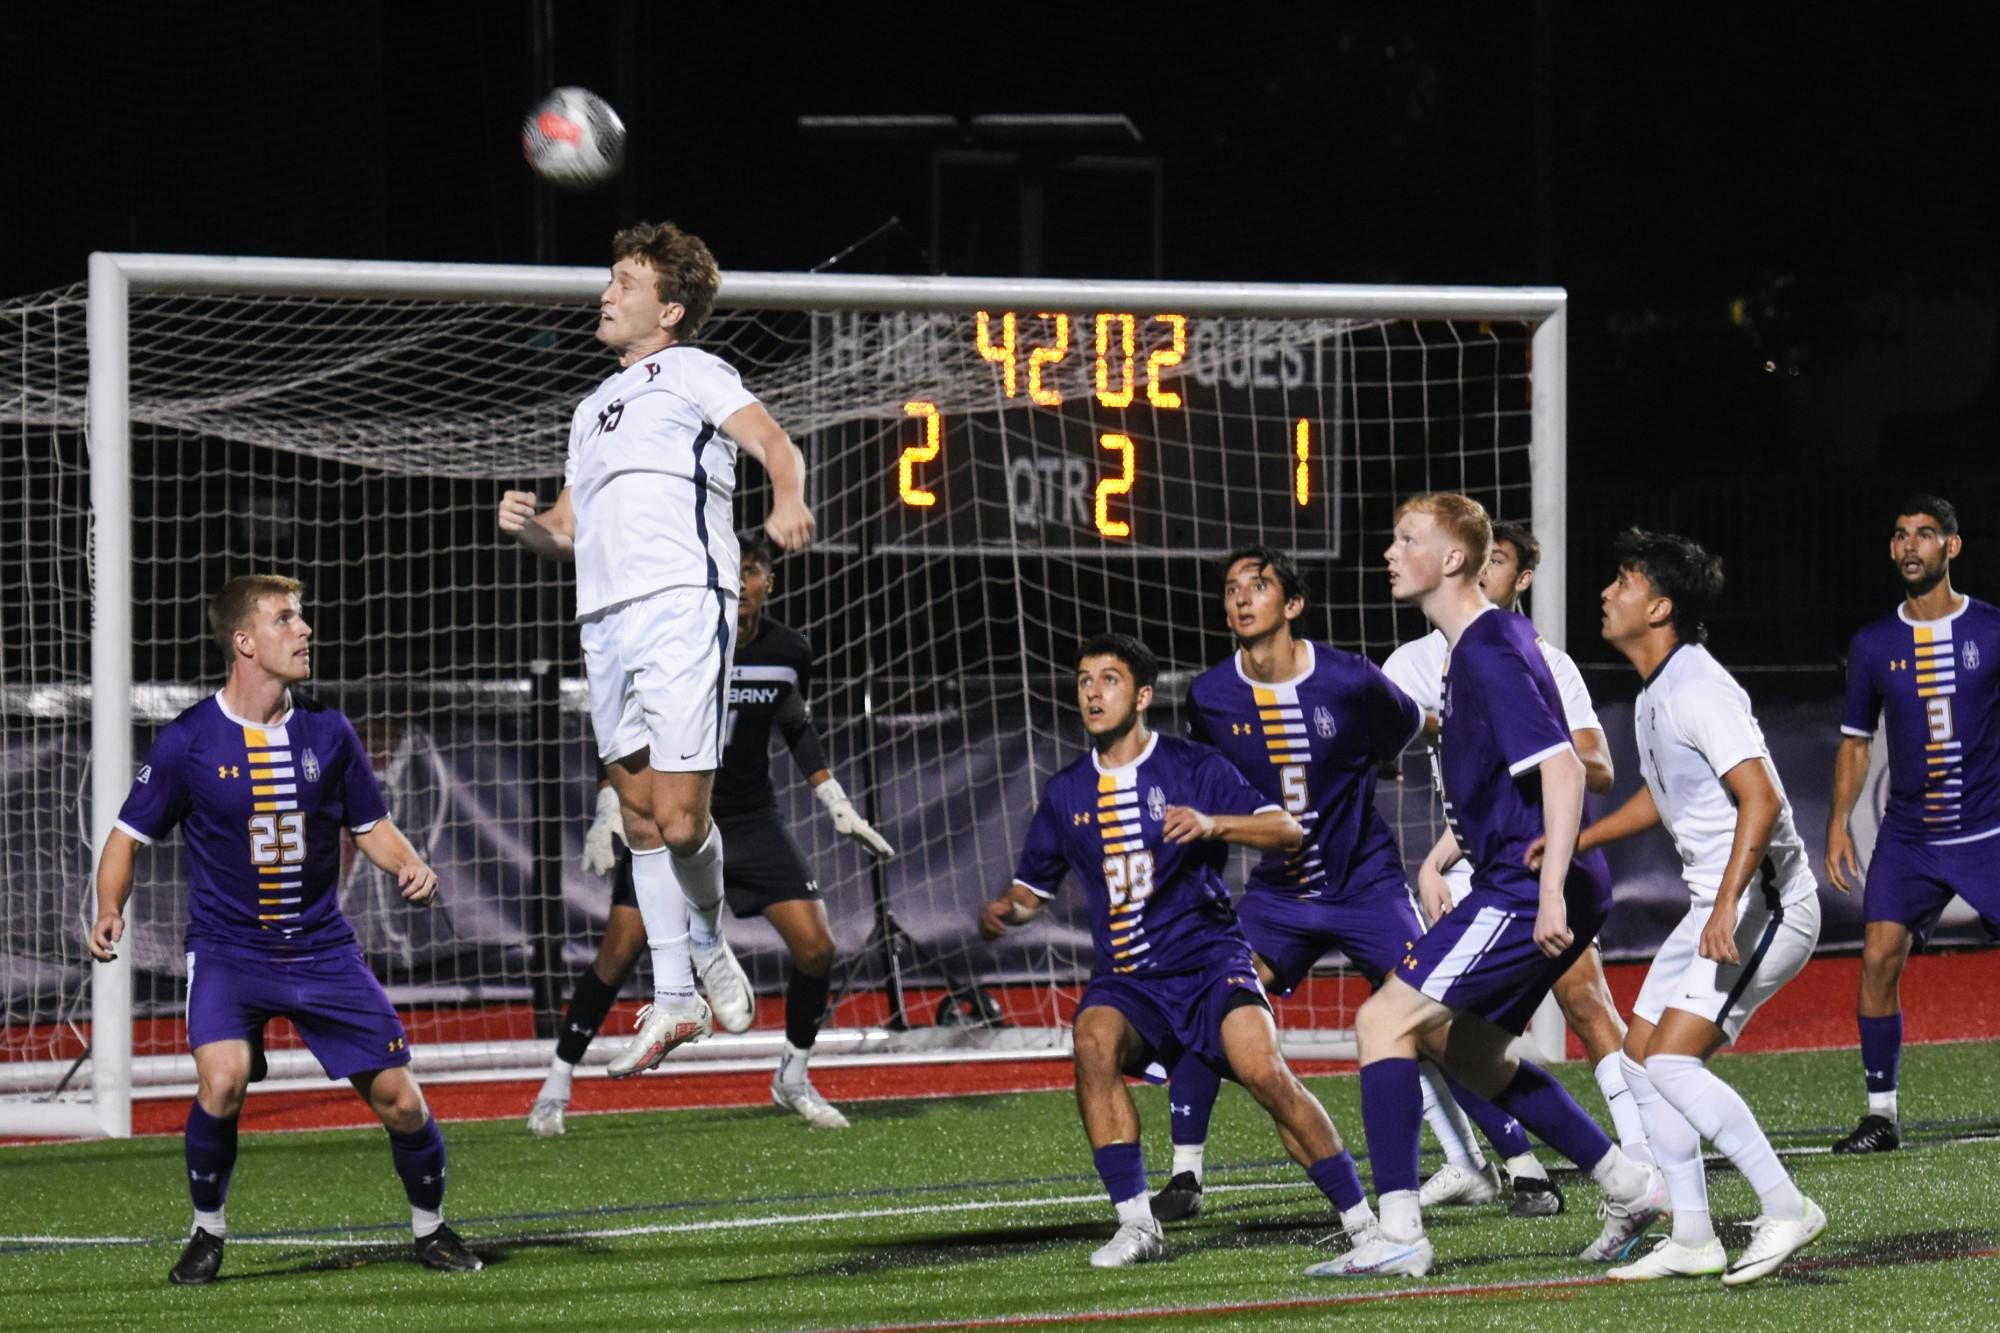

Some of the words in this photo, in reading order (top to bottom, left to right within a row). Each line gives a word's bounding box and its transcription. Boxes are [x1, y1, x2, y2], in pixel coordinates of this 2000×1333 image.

[899, 401, 942, 506] 2
[1295, 417, 1311, 507] 1
[1011, 456, 1090, 527] QTR
[1094, 433, 1136, 538] 2
[1926, 695, 1954, 743] 3
[1280, 763, 1310, 813] 5
[248, 811, 307, 865] 23
[1103, 848, 1155, 907] 28
